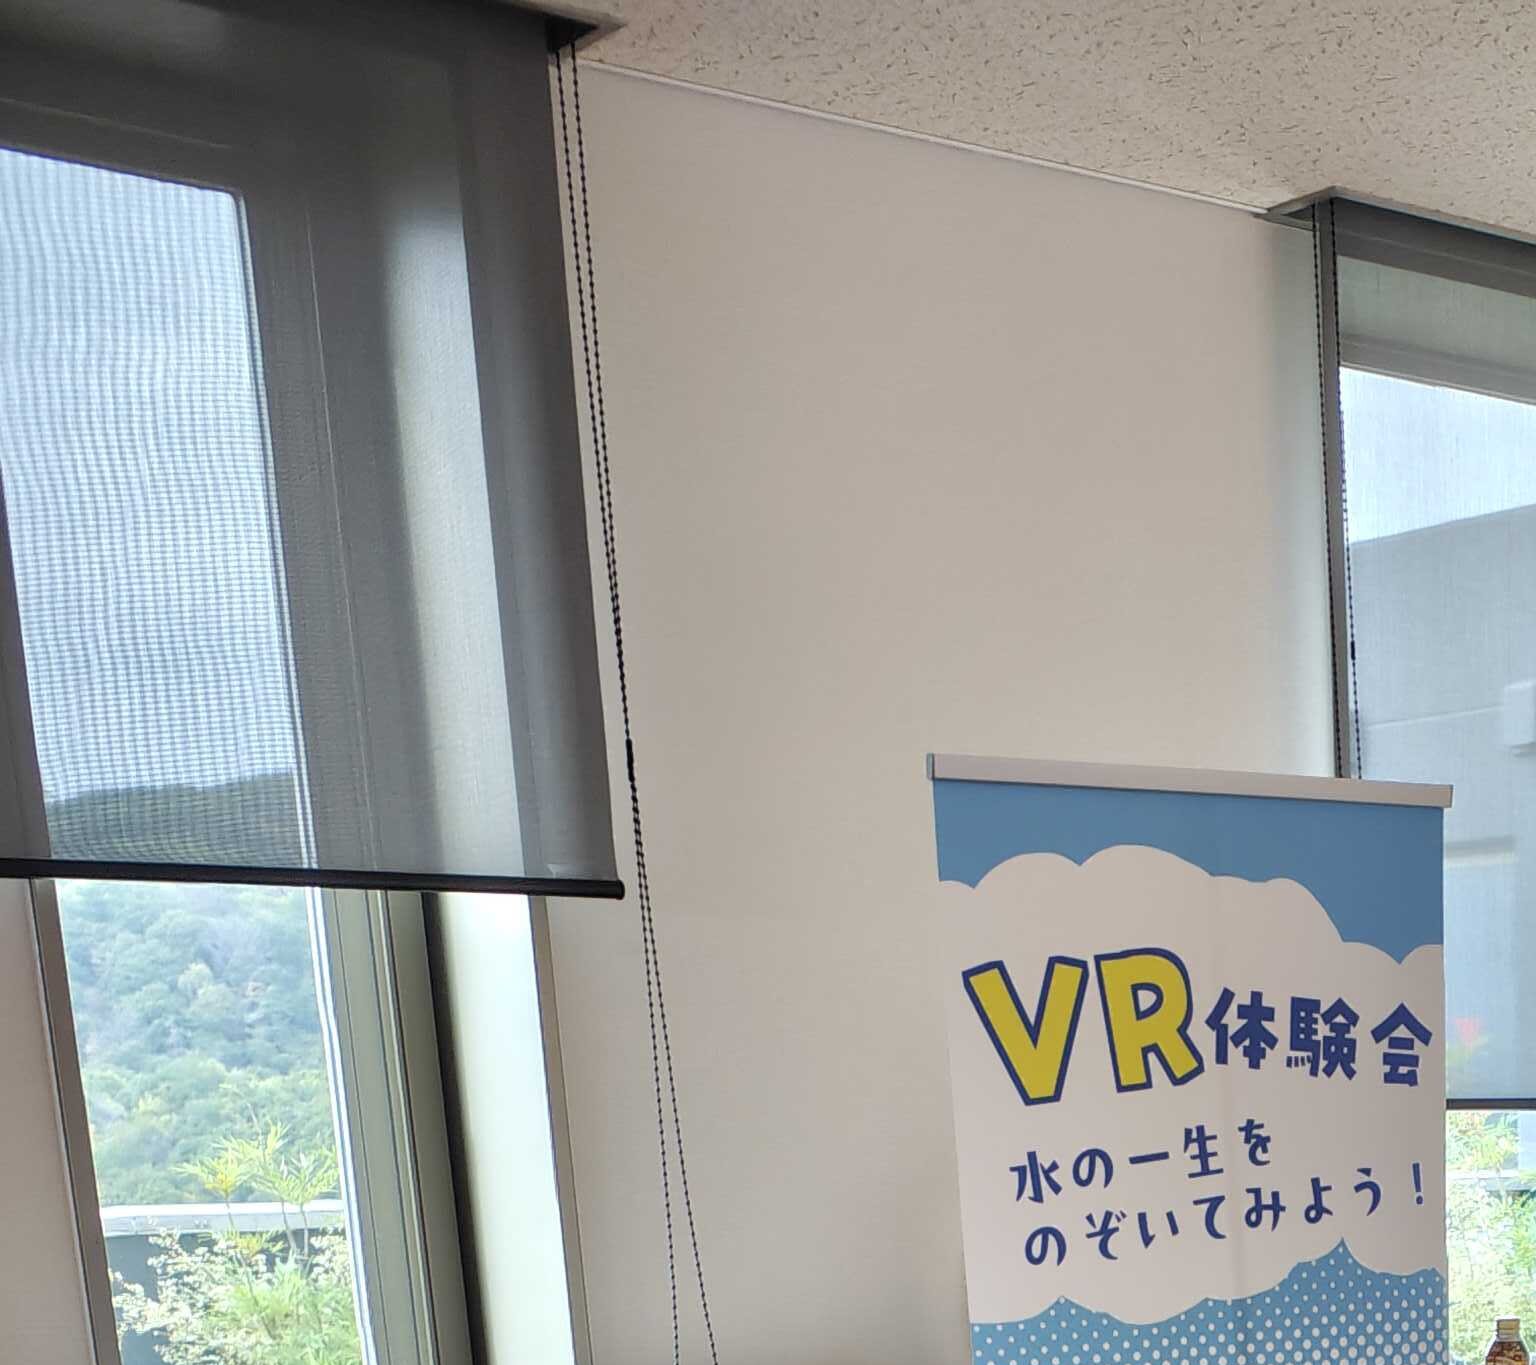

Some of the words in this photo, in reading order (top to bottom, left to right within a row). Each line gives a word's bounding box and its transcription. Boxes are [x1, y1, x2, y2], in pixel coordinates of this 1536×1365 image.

[962, 947, 1434, 1106] VR体験会
[1009, 1118, 1271, 1204] 水の一生を
